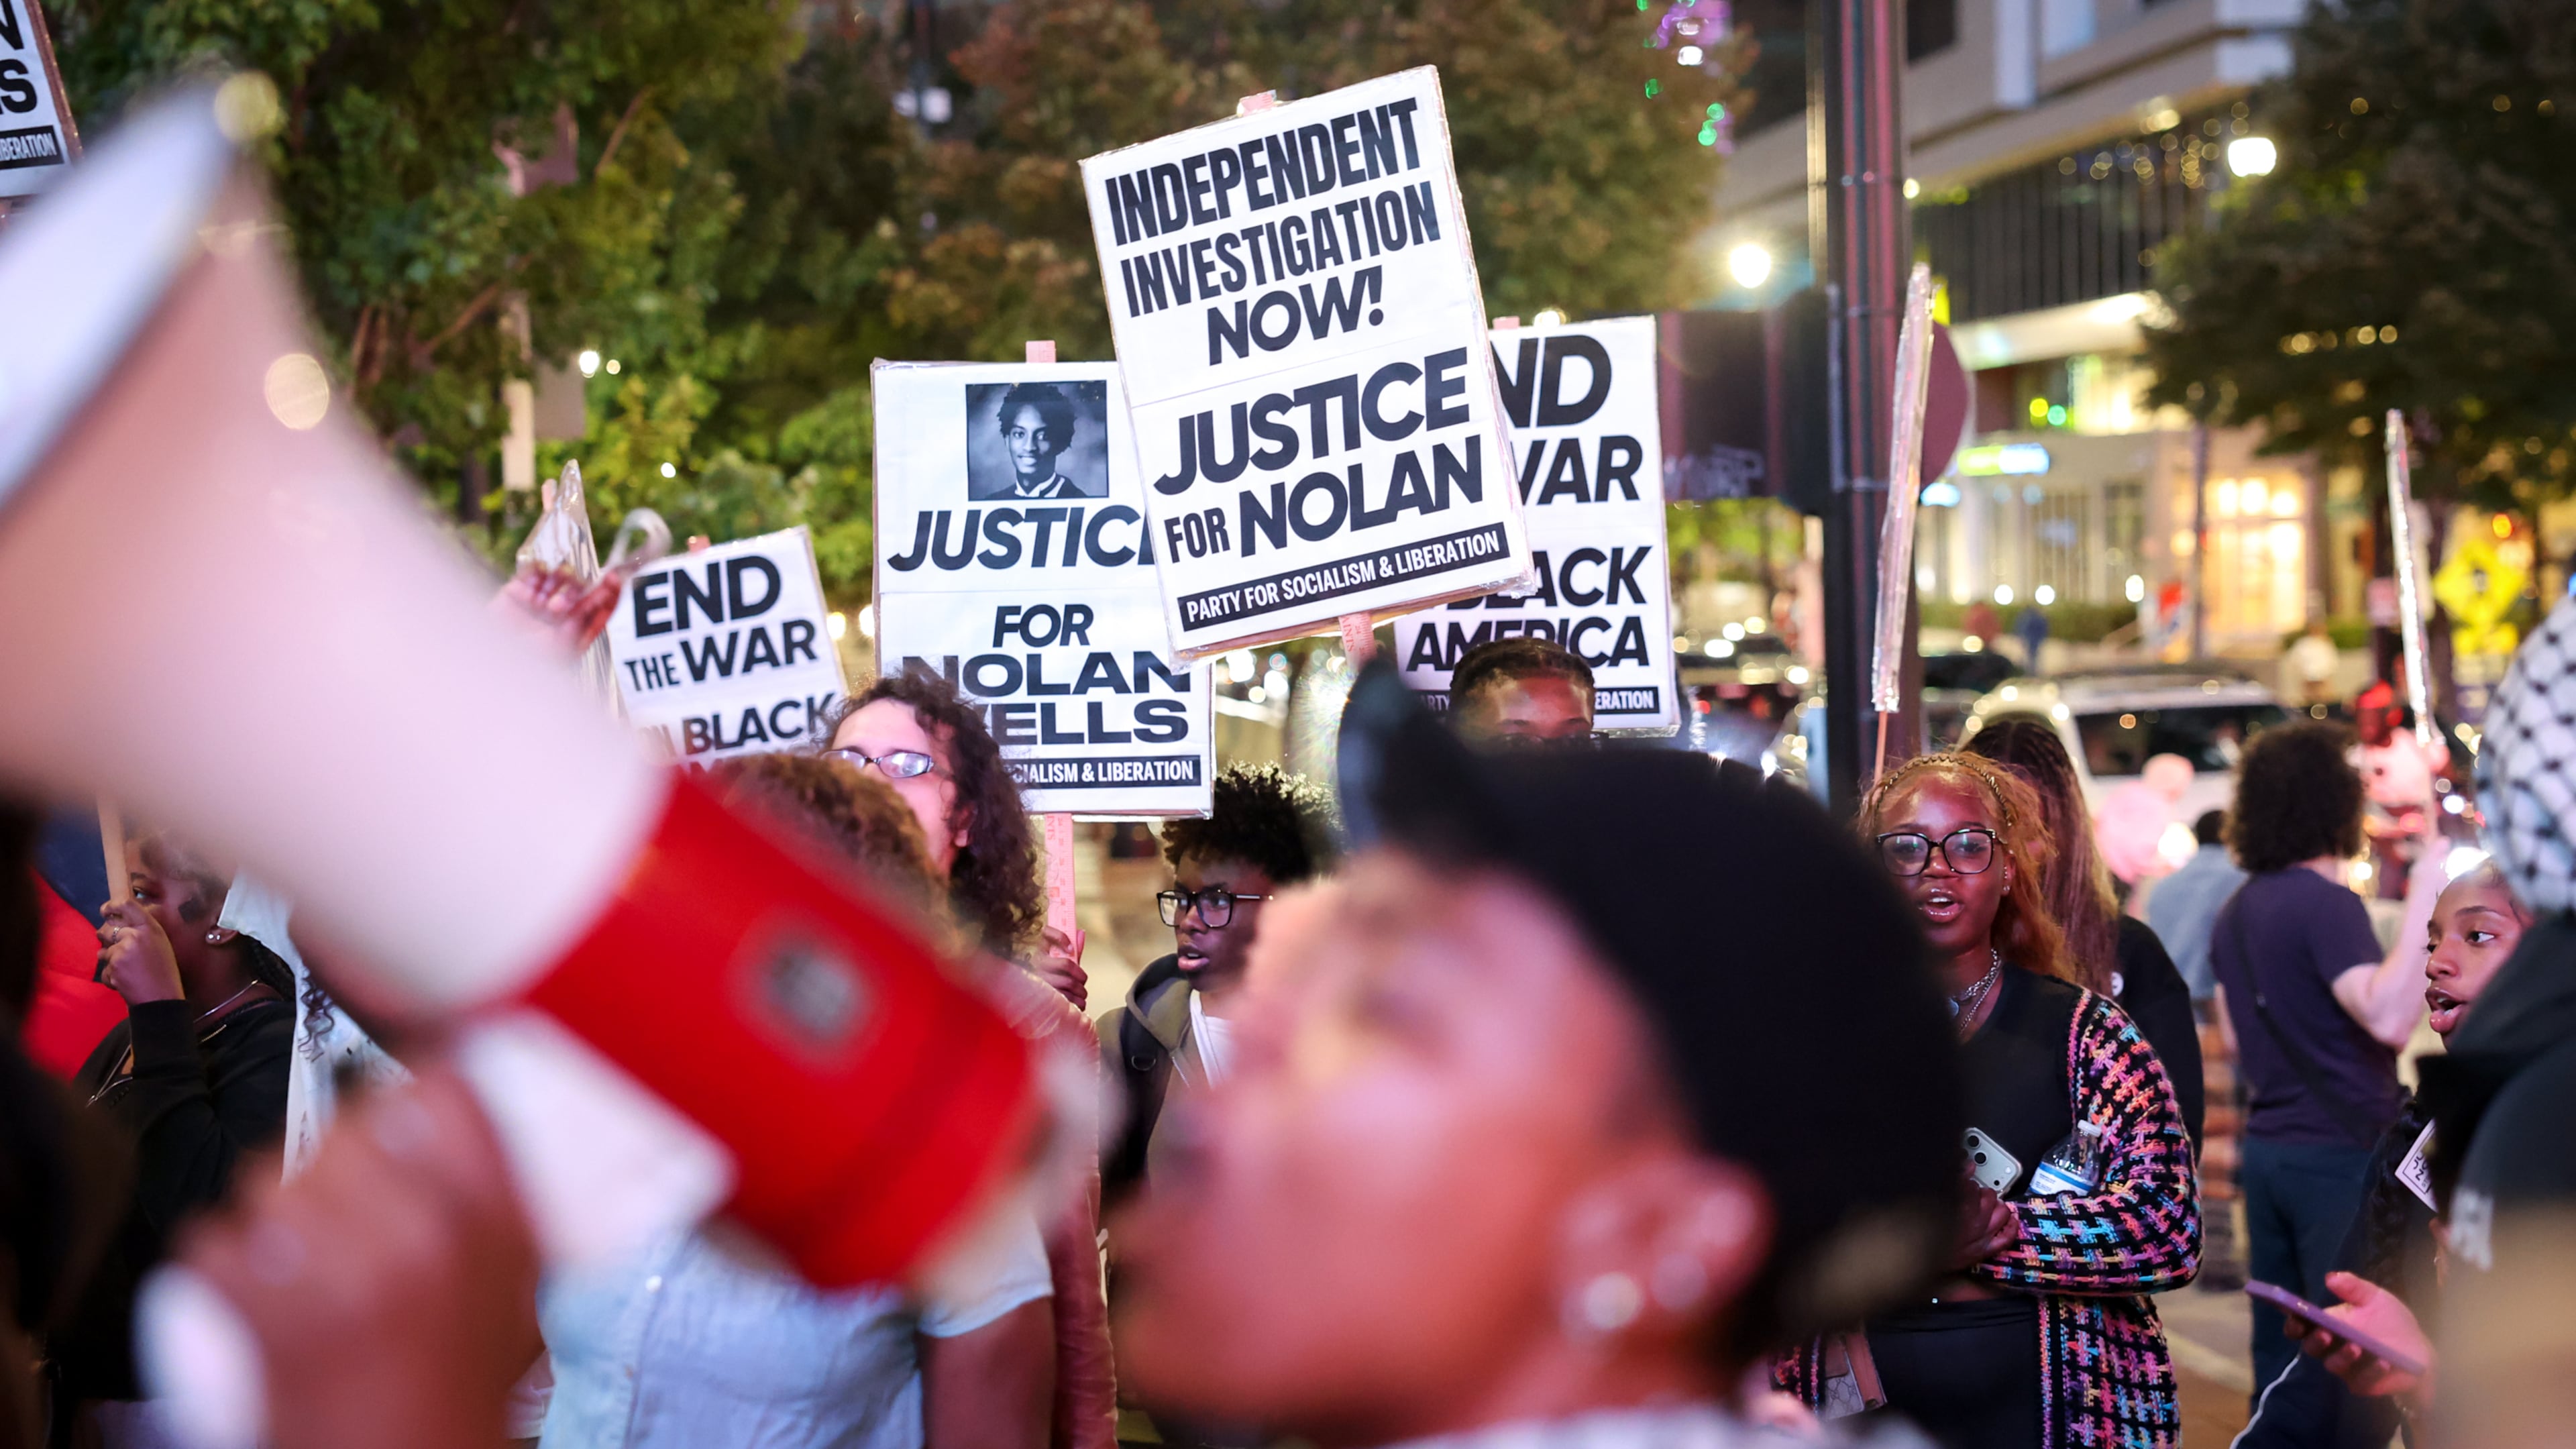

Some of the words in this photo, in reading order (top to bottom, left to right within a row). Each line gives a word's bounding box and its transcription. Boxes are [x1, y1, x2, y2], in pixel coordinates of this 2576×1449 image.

[0, 133, 57, 161] BERATION
[1105, 97, 1419, 246] INDEPENDENT
[1120, 180, 1441, 318] INVESTIGATION
[1208, 265, 1384, 366] NOW!
[1490, 335, 1612, 428] ND
[1153, 347, 1469, 495] JUSTICE
[1164, 509, 1230, 563] FOR
[1240, 434, 1483, 557] NOLAN
[633, 556, 781, 638] END
[1186, 589, 1241, 623] PARTY
[1244, 582, 1278, 610] FOR
[1281, 559, 1376, 599] SOCIALISM
[1379, 555, 1395, 578] &
[1395, 529, 1500, 574] LIBERATION
[1446, 545, 1653, 610] ACK
[625, 652, 680, 692] THE
[680, 620, 817, 682] WAR
[993, 604, 1093, 647] FOR
[683, 692, 835, 755] BLACK
[976, 698, 1189, 745] ELLS
[1595, 690, 1654, 710] ERATION
[1006, 763, 1077, 784] CIALISM
[1081, 762, 1095, 782] &
[1098, 760, 1193, 782] LIBERATION
